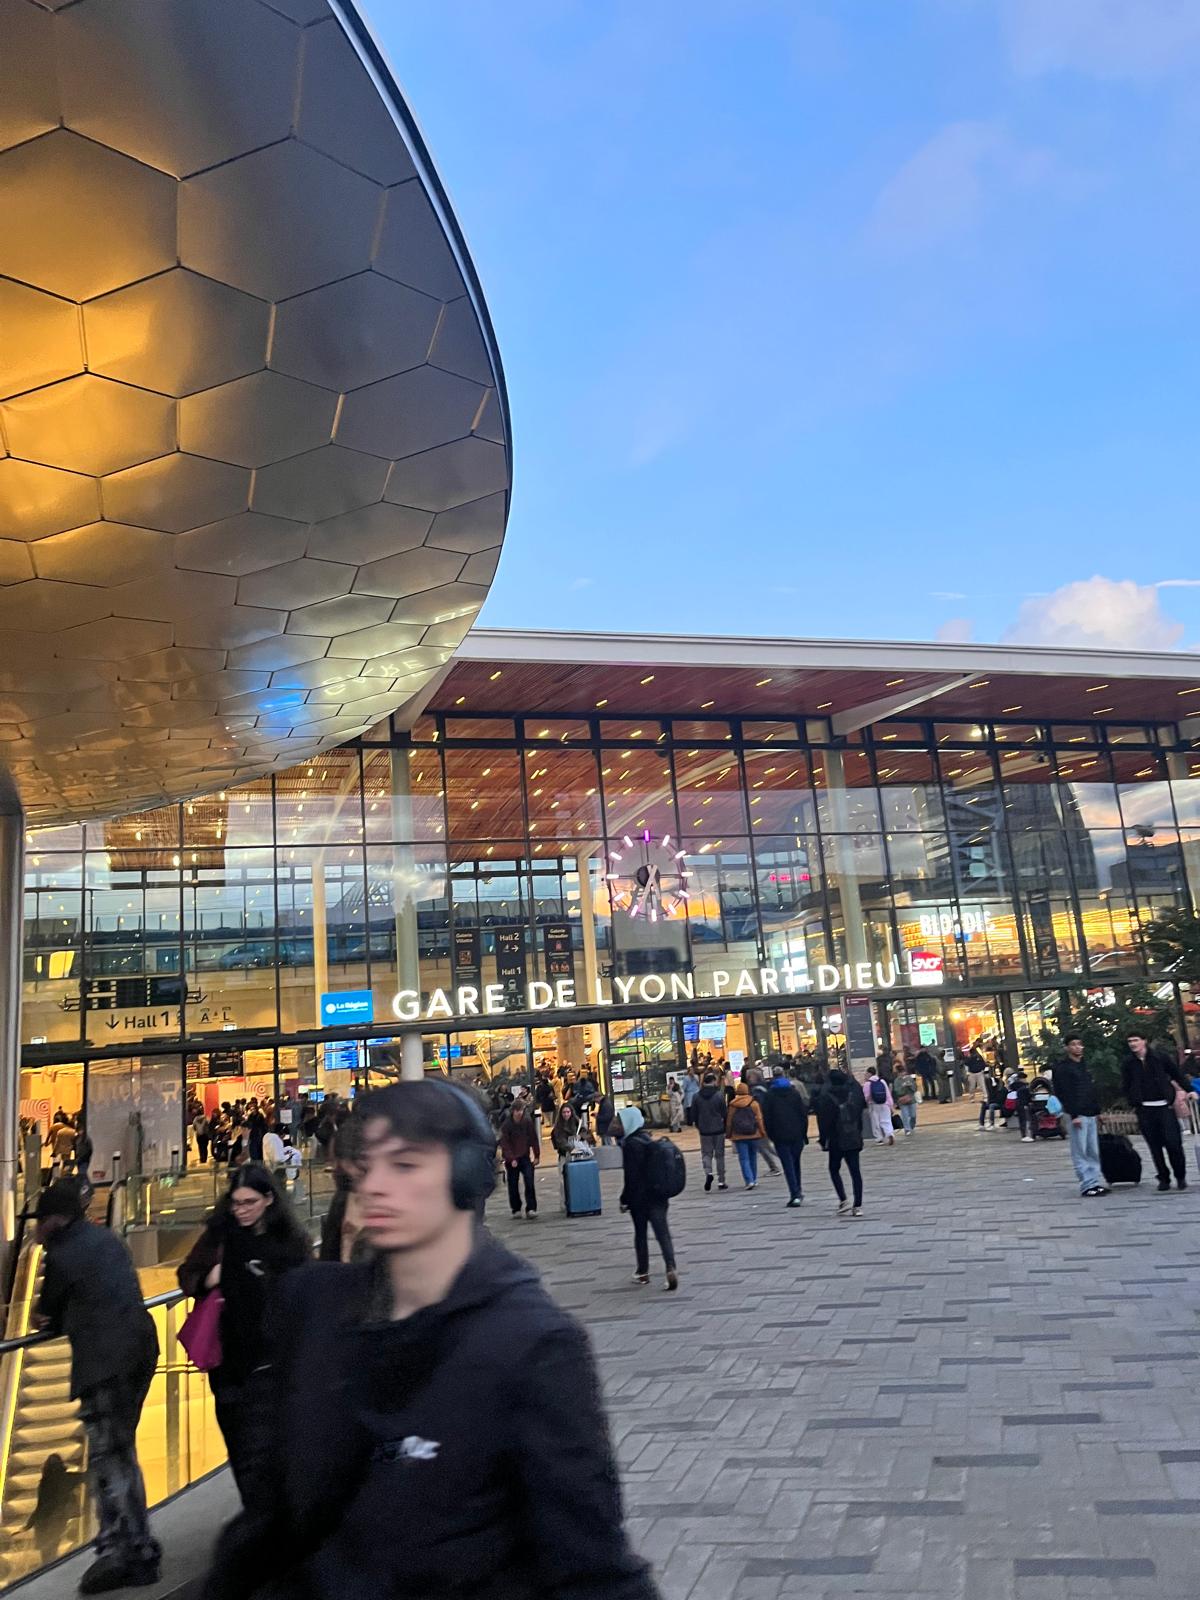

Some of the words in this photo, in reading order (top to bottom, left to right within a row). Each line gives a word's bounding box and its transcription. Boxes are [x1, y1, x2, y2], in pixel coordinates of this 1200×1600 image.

[514, 932, 520, 940] 2
[912, 956, 942, 970] SNCF
[501, 968, 516, 976] Hall
[516, 966, 521, 975] 1
[392, 984, 506, 1021] GARE
[527, 979, 577, 1010] DE
[595, 972, 695, 1005] LYON
[124, 1014, 157, 1029] Hall
[160, 1011, 169, 1026] 1
[200, 1012, 210, 1022] A
[223, 1011, 230, 1021] L
